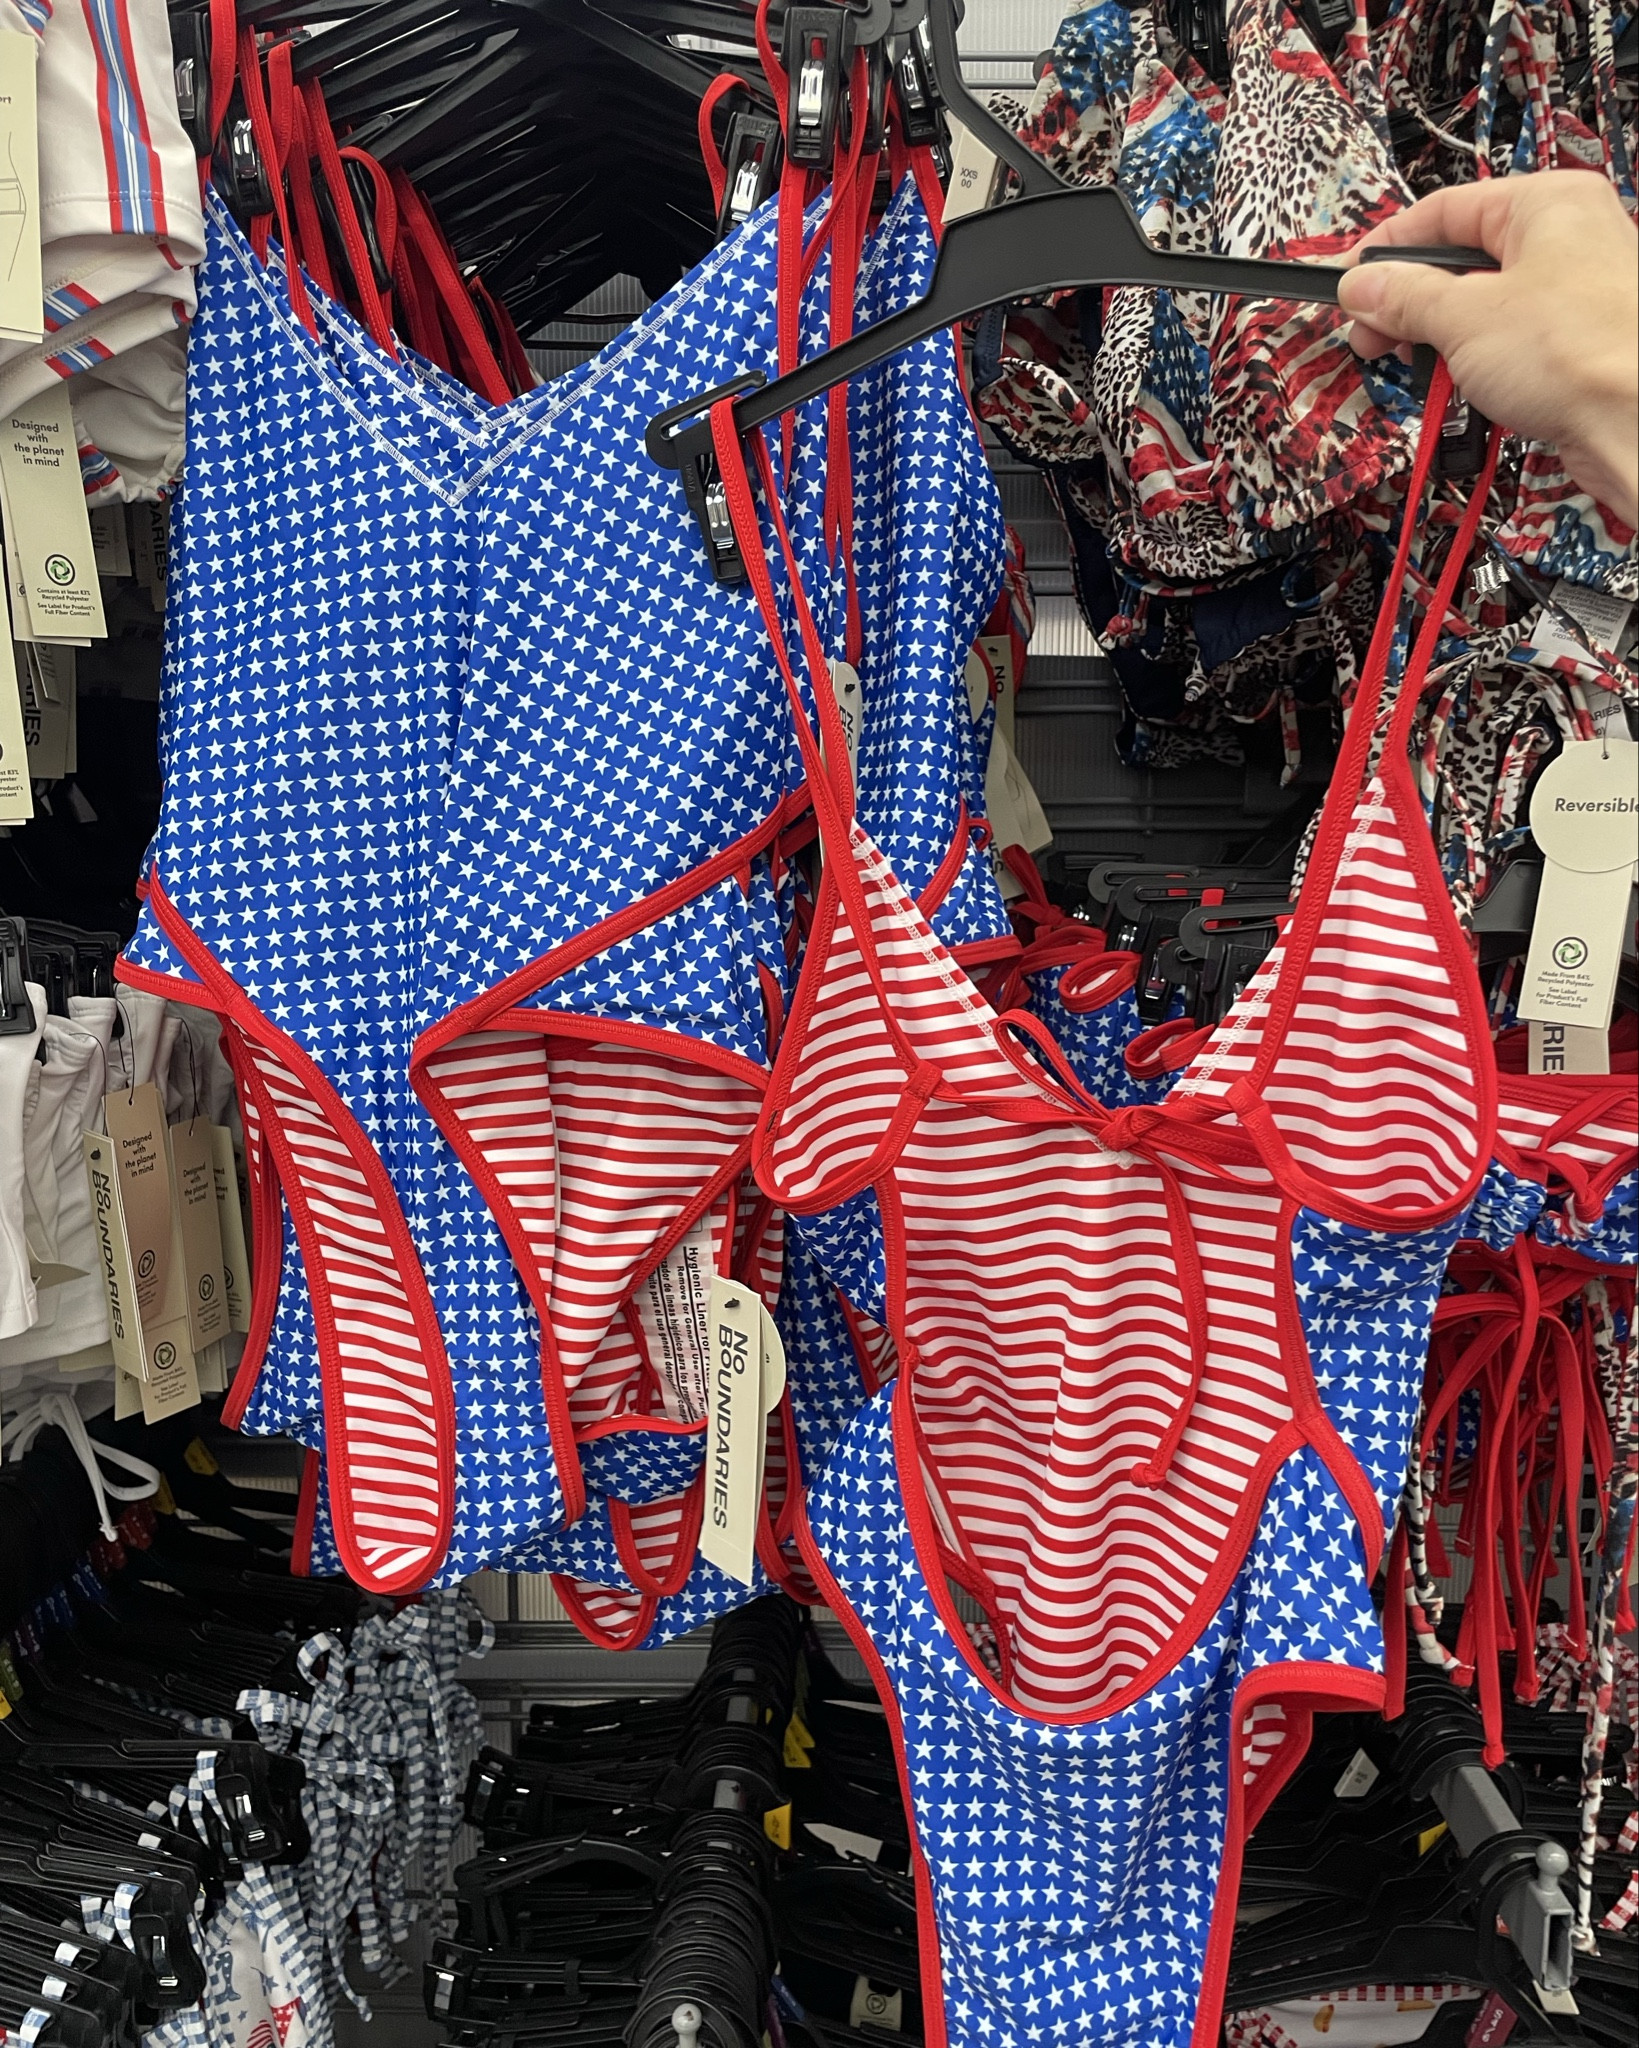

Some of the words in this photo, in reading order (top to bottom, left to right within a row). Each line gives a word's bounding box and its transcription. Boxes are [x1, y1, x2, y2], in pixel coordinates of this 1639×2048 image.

[960, 167, 978, 180] XXS
[12, 419, 59, 433] Designed
[27, 433, 48, 443] with
[14, 442, 30, 453] the
[33, 444, 64, 456] planet
[23, 455, 33, 464] in
[34, 457, 60, 467] mind
[994, 666, 1005, 693] NO
[122, 1131, 152, 1148] Designed
[132, 1145, 146, 1155] with
[125, 1159, 135, 1169] the
[136, 1152, 156, 1167] planet
[131, 1169, 137, 1178] in
[138, 1163, 154, 1175] mind
[100, 1173, 111, 1210] NO
[92, 1169, 125, 1340] BOUNDARIES
[663, 1283, 673, 1293] de
[687, 1247, 703, 1298] Hygienic
[696, 1303, 707, 1332] Liner
[649, 1291, 660, 1307] para
[656, 1319, 664, 1331] uso
[677, 1266, 687, 1300] Remove
[685, 1317, 697, 1351] General
[694, 1373, 702, 1394] after
[658, 1332, 672, 1359] general
[733, 1330, 748, 1375] NO
[677, 1353, 686, 1370] para
[680, 1372, 688, 1384] los
[713, 1323, 733, 1529] BOUNDARIES
